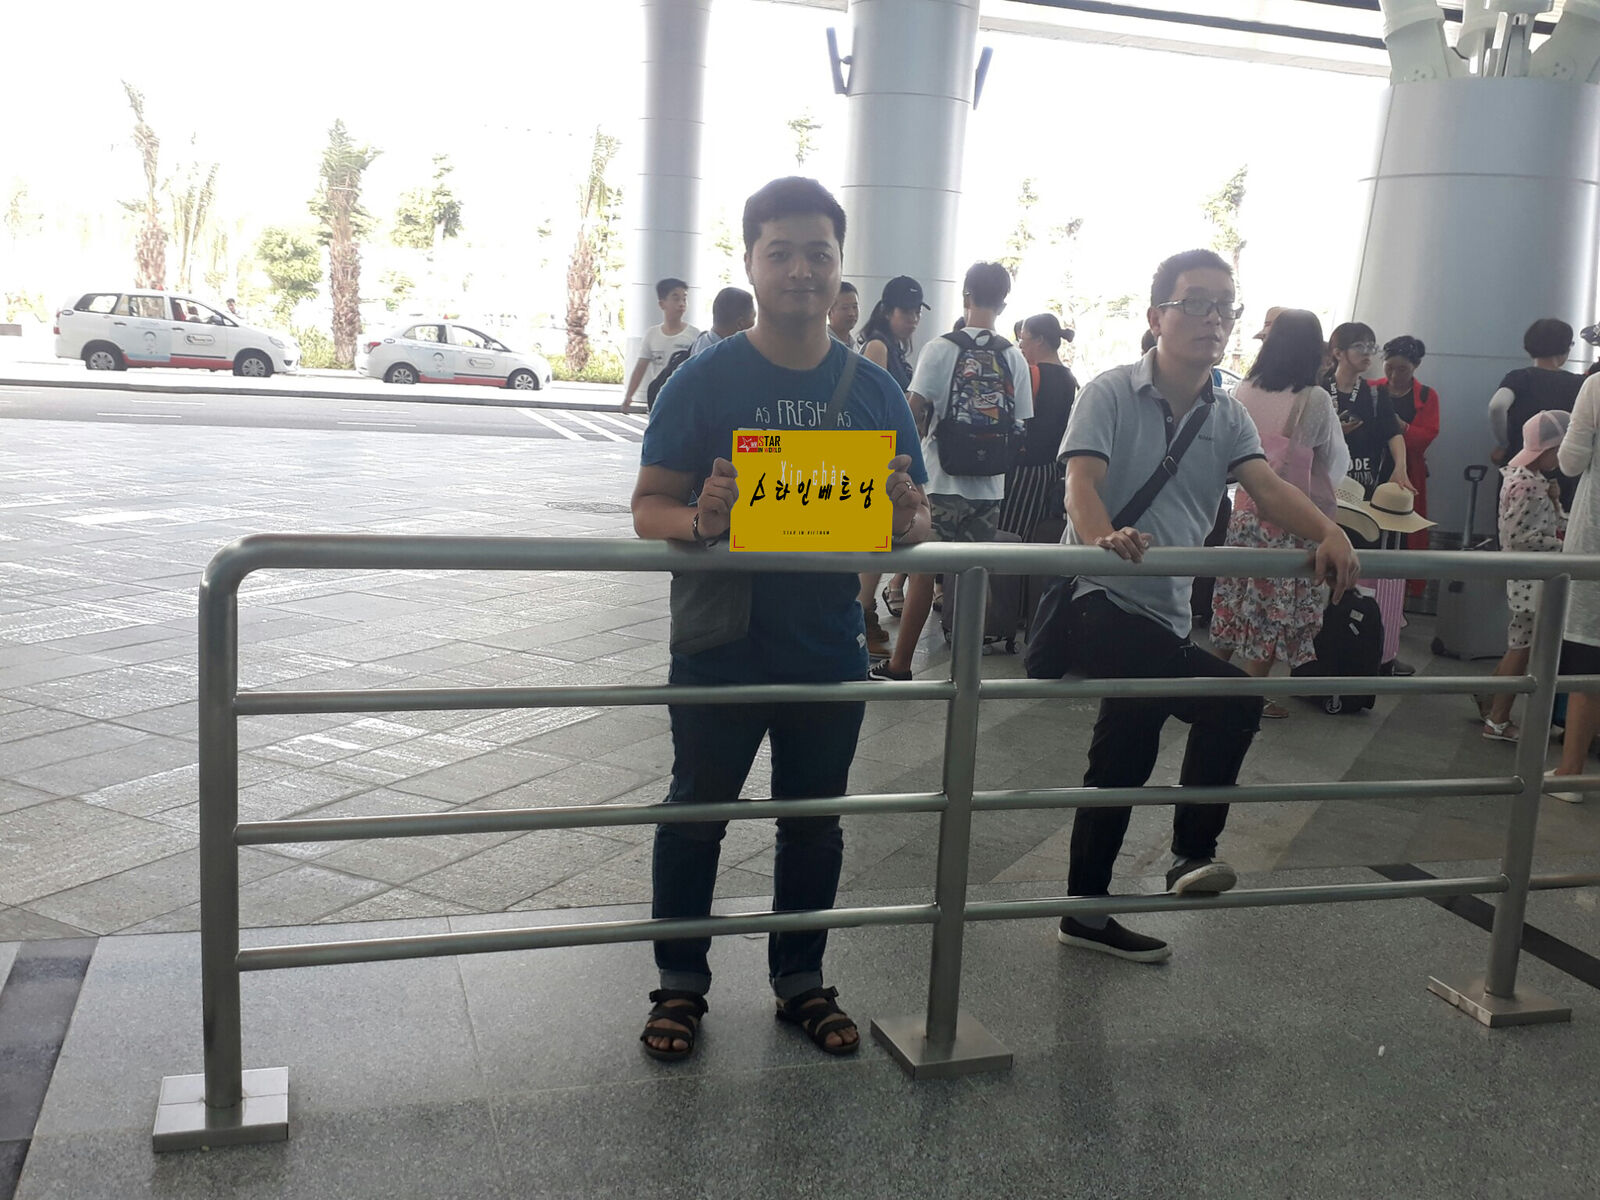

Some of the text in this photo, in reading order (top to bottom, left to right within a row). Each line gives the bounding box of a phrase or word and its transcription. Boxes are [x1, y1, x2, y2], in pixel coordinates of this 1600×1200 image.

[756, 400, 852, 428] AS FRESH AS
[759, 436, 780, 446] STAR
[781, 461, 802, 486] Xin
